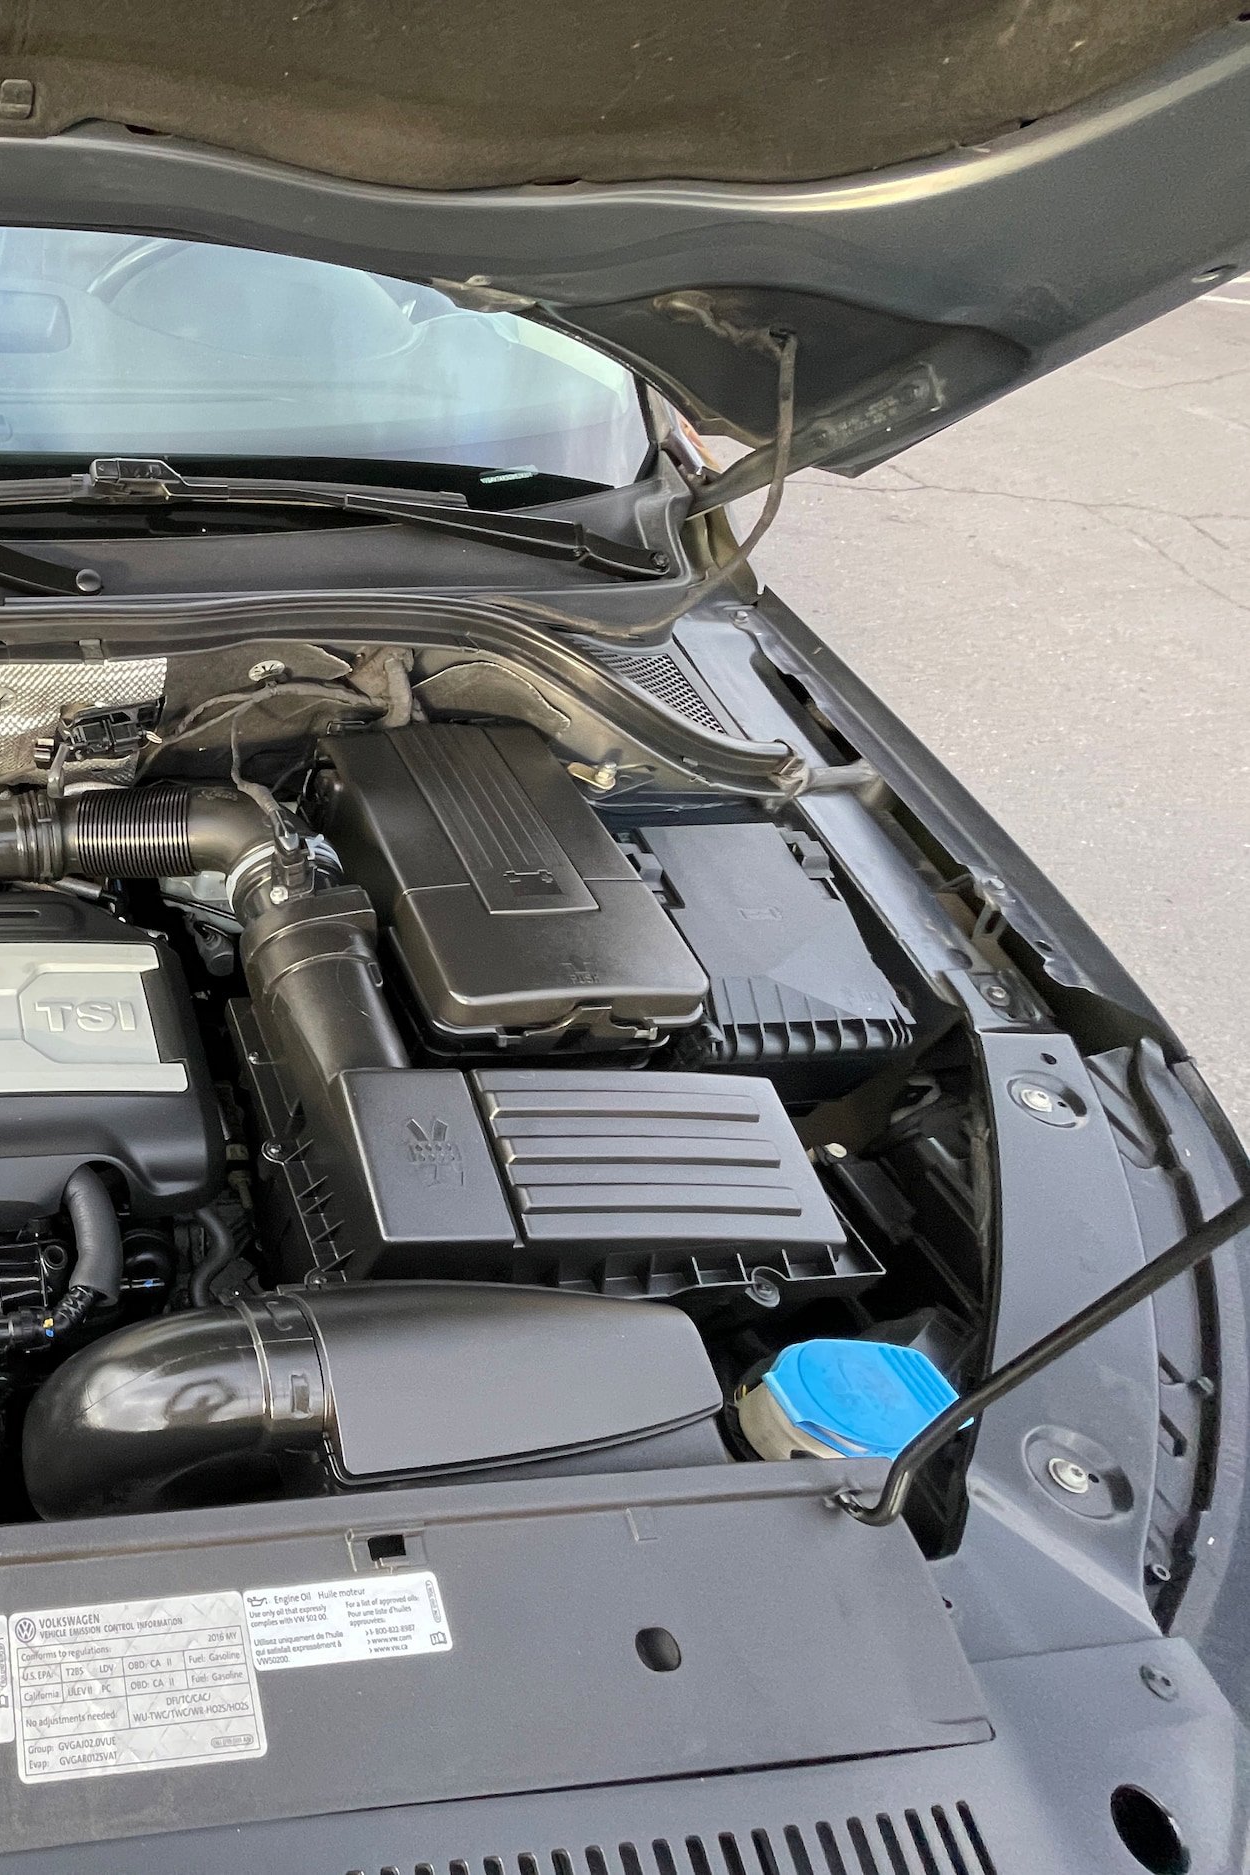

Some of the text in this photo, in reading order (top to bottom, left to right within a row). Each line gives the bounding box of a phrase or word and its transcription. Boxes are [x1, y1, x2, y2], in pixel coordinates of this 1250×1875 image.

[567, 974, 600, 984] PUSH
[34, 1000, 136, 1031] TSI
[318, 1587, 364, 1598] Huile moteur
[274, 1592, 311, 1605] Engine Oil
[262, 1609, 275, 1618] only
[298, 1604, 326, 1614] expressly
[39, 1613, 99, 1628] VOLKSWAGEN
[250, 1618, 278, 1628] complies
[40, 1617, 182, 1638] VEHICLE EMISSION CONTROL INFORMATION
[225, 1631, 236, 1639] MY
[21, 1650, 56, 1661] Conforms
[58, 1649, 66, 1657] to
[208, 1650, 239, 1661] Gasoline
[150, 1659, 160, 1667] CA
[211, 1670, 243, 1681] Gasoline
[152, 1678, 163, 1687] CA
[26, 1718, 36, 1727] No
[38, 1713, 85, 1728] adjustments
